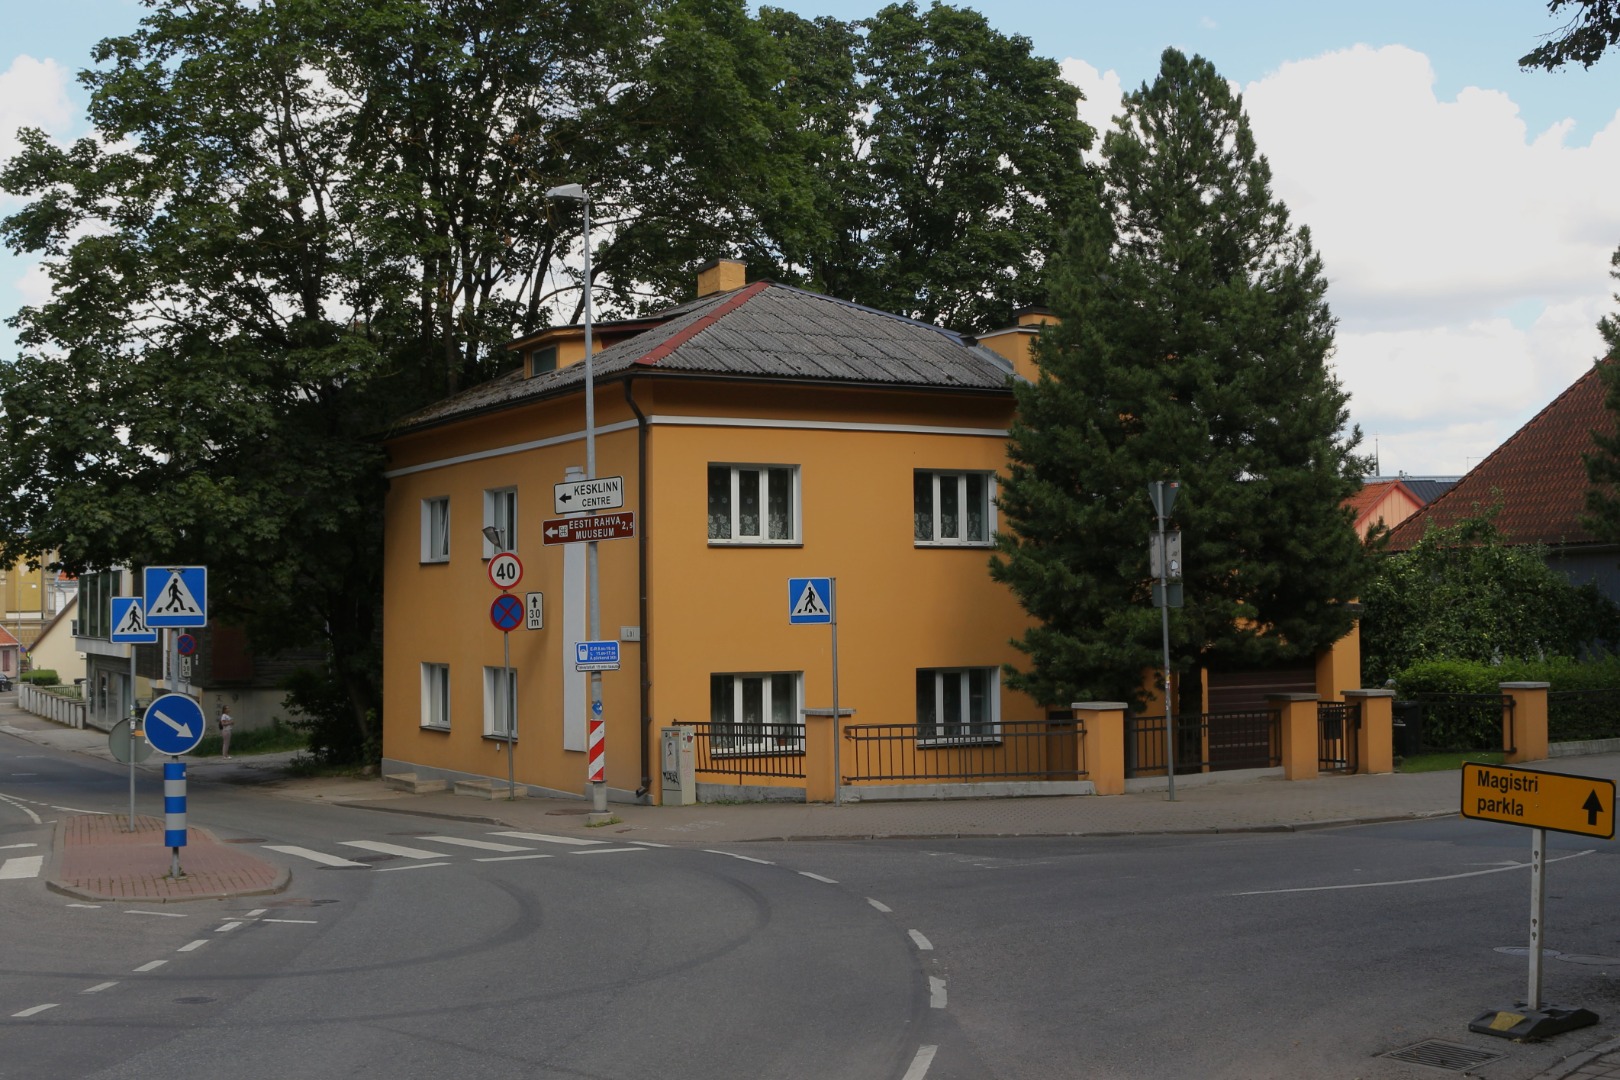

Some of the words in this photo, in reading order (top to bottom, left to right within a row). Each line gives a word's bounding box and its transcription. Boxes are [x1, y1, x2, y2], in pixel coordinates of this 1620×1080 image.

[574, 481, 618, 496] KESKLINN
[581, 496, 611, 507] CENTRE
[569, 519, 592, 529] EESTI
[594, 516, 621, 528] RAHVA
[575, 528, 615, 540] MUUSEUM
[496, 562, 516, 580] 40
[529, 608, 541, 619] 30
[531, 619, 539, 627] m
[1477, 770, 1538, 793] Magistri
[1477, 797, 1524, 817] parkla
